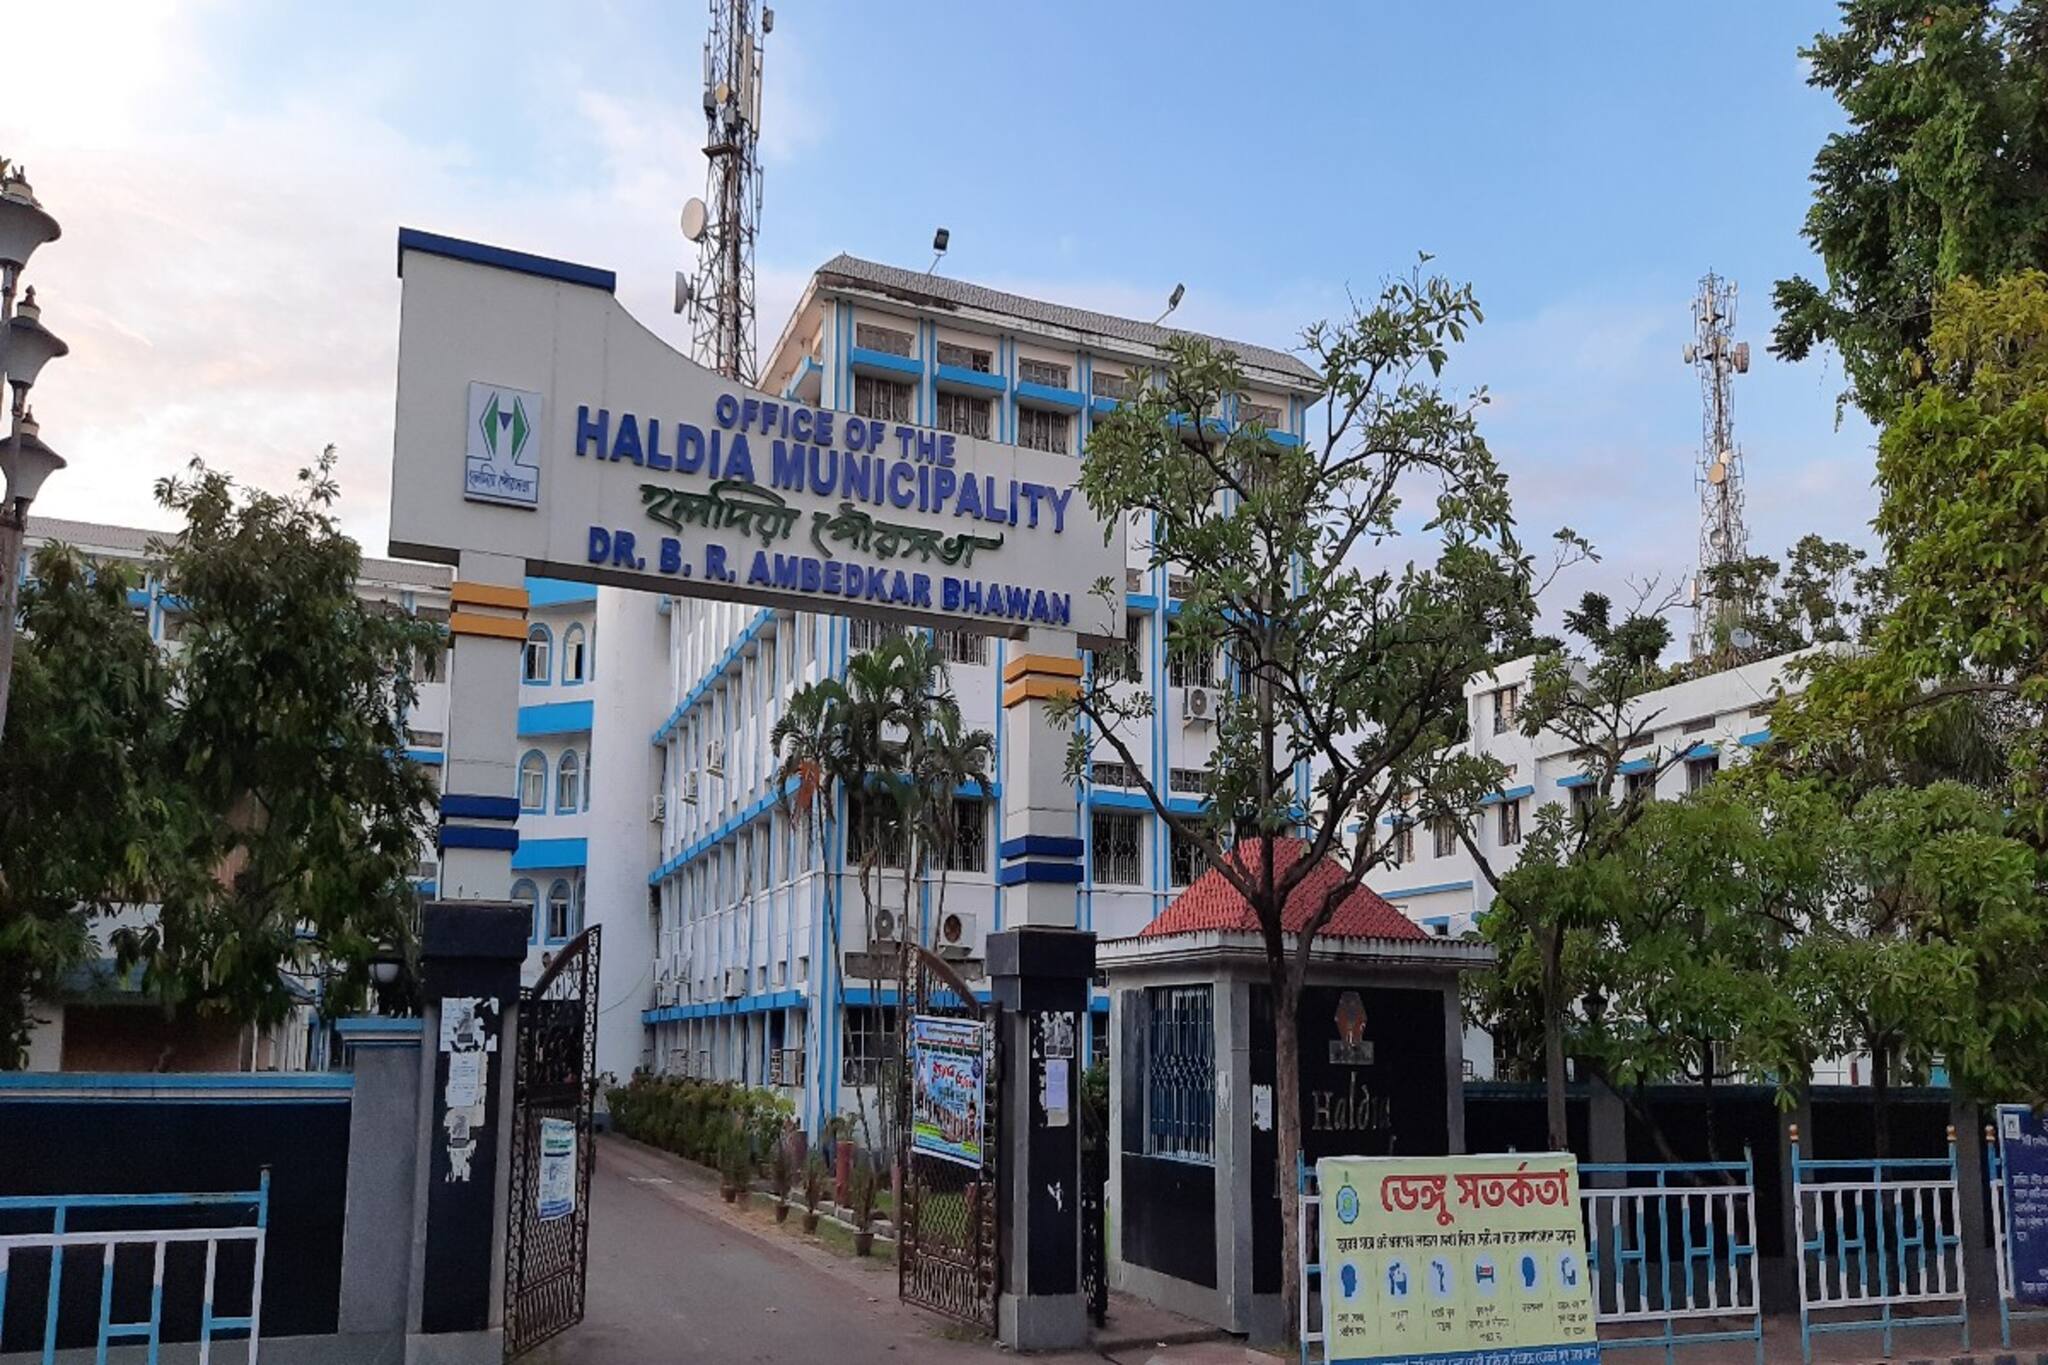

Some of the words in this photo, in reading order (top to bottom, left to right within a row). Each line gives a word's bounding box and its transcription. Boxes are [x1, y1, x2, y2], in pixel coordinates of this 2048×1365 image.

[576, 405, 756, 484] HALDIA
[770, 438, 1074, 534] MUNICIPALITY
[716, 393, 834, 448] OFFICE
[843, 417, 886, 453] OF
[896, 425, 957, 468] THE
[639, 480, 802, 548] হলদিয়া
[811, 502, 1005, 569] পৌরসভা
[588, 525, 646, 571] DR.
[660, 536, 692, 577] B.
[704, 542, 737, 583] R.
[746, 549, 933, 609] AMBEDKAR
[940, 574, 1072, 625] BHAWAN
[1380, 1174, 1455, 1226] ডেঙ্গু
[1453, 1161, 1569, 1209] সতর্কতা
